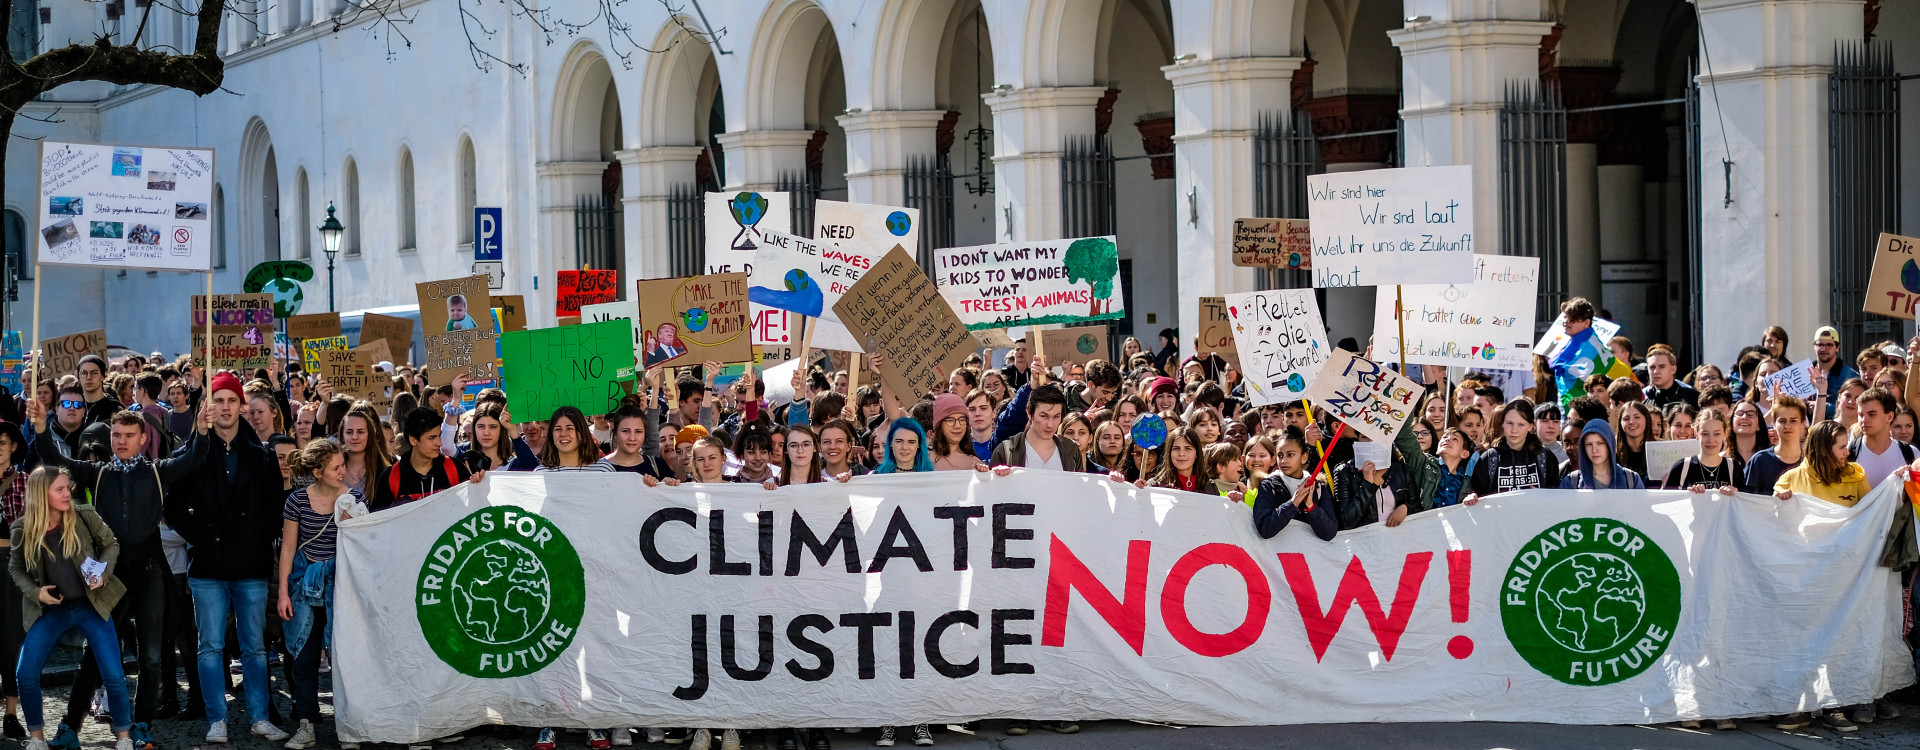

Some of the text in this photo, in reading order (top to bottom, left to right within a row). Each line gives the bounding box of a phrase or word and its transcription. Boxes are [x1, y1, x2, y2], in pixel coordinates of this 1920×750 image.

[1310, 181, 1386, 201] Wir sind hier
[1359, 199, 1459, 225] Wir sind laut
[481, 214, 496, 254] P
[820, 225, 854, 239] NEED
[1235, 220, 1249, 235] They
[1234, 241, 1245, 253] So
[1235, 234, 1267, 243] remember
[1312, 233, 1472, 256] Weil ihr uns die Zukunft
[1888, 238, 1914, 254] Die
[763, 233, 871, 270] LIKE THE WAVES
[942, 247, 1058, 268] I DON'T WANT MY
[1241, 253, 1281, 265] we have to
[558, 274, 576, 287] MAKE
[949, 265, 1071, 286] KIDS TO WONDER
[1317, 266, 1361, 288] klaut
[1491, 266, 1534, 283] retten!
[427, 278, 482, 300] OBACHT
[684, 278, 744, 303] MAKE THE
[846, 261, 904, 316] Erst wenn ihr
[979, 284, 1020, 298] WHAT
[195, 296, 199, 309] I
[261, 297, 270, 308] in
[709, 300, 743, 315] GREAT
[861, 307, 878, 326] alle
[874, 284, 903, 308] Bäume
[1031, 289, 1089, 308] ANIMALS
[1256, 294, 1307, 321] Rettet
[195, 308, 273, 326] UNICORNS
[870, 317, 888, 336] alle
[884, 301, 905, 320] Fische
[1422, 303, 1454, 322] hattet
[711, 314, 746, 335] AGAIN!
[878, 330, 896, 350] alle
[890, 313, 914, 335] Kohle
[920, 323, 937, 342] habt
[1278, 320, 1306, 348] die
[218, 334, 236, 346] our
[305, 337, 346, 350] ABWARTEN
[425, 337, 440, 348] IHR
[512, 322, 610, 363] THERE
[260, 345, 272, 357] to
[328, 352, 356, 361] SAVE
[428, 347, 444, 358] AUF
[784, 348, 792, 360] B
[886, 346, 901, 359] die
[221, 357, 268, 368] our planet
[331, 364, 352, 375] THE
[430, 355, 472, 372] DÜNNEM
[540, 356, 603, 388] IS NO
[902, 353, 922, 378] werdet
[1342, 356, 1413, 405] Rettet
[526, 380, 621, 421] PLANET B
[913, 388, 922, 398] B
[1509, 466, 1528, 475] kein
[1500, 475, 1537, 486] mensch
[639, 503, 1036, 577] CLIMATE
[421, 511, 553, 606] FRIDAYS FOR
[1506, 523, 1645, 606] FRIDAYS FOR
[1040, 532, 1476, 664] NOW!
[479, 618, 573, 673] FUTURE
[672, 608, 1036, 702] JUSTICE
[1569, 623, 1669, 682] FUTURE
